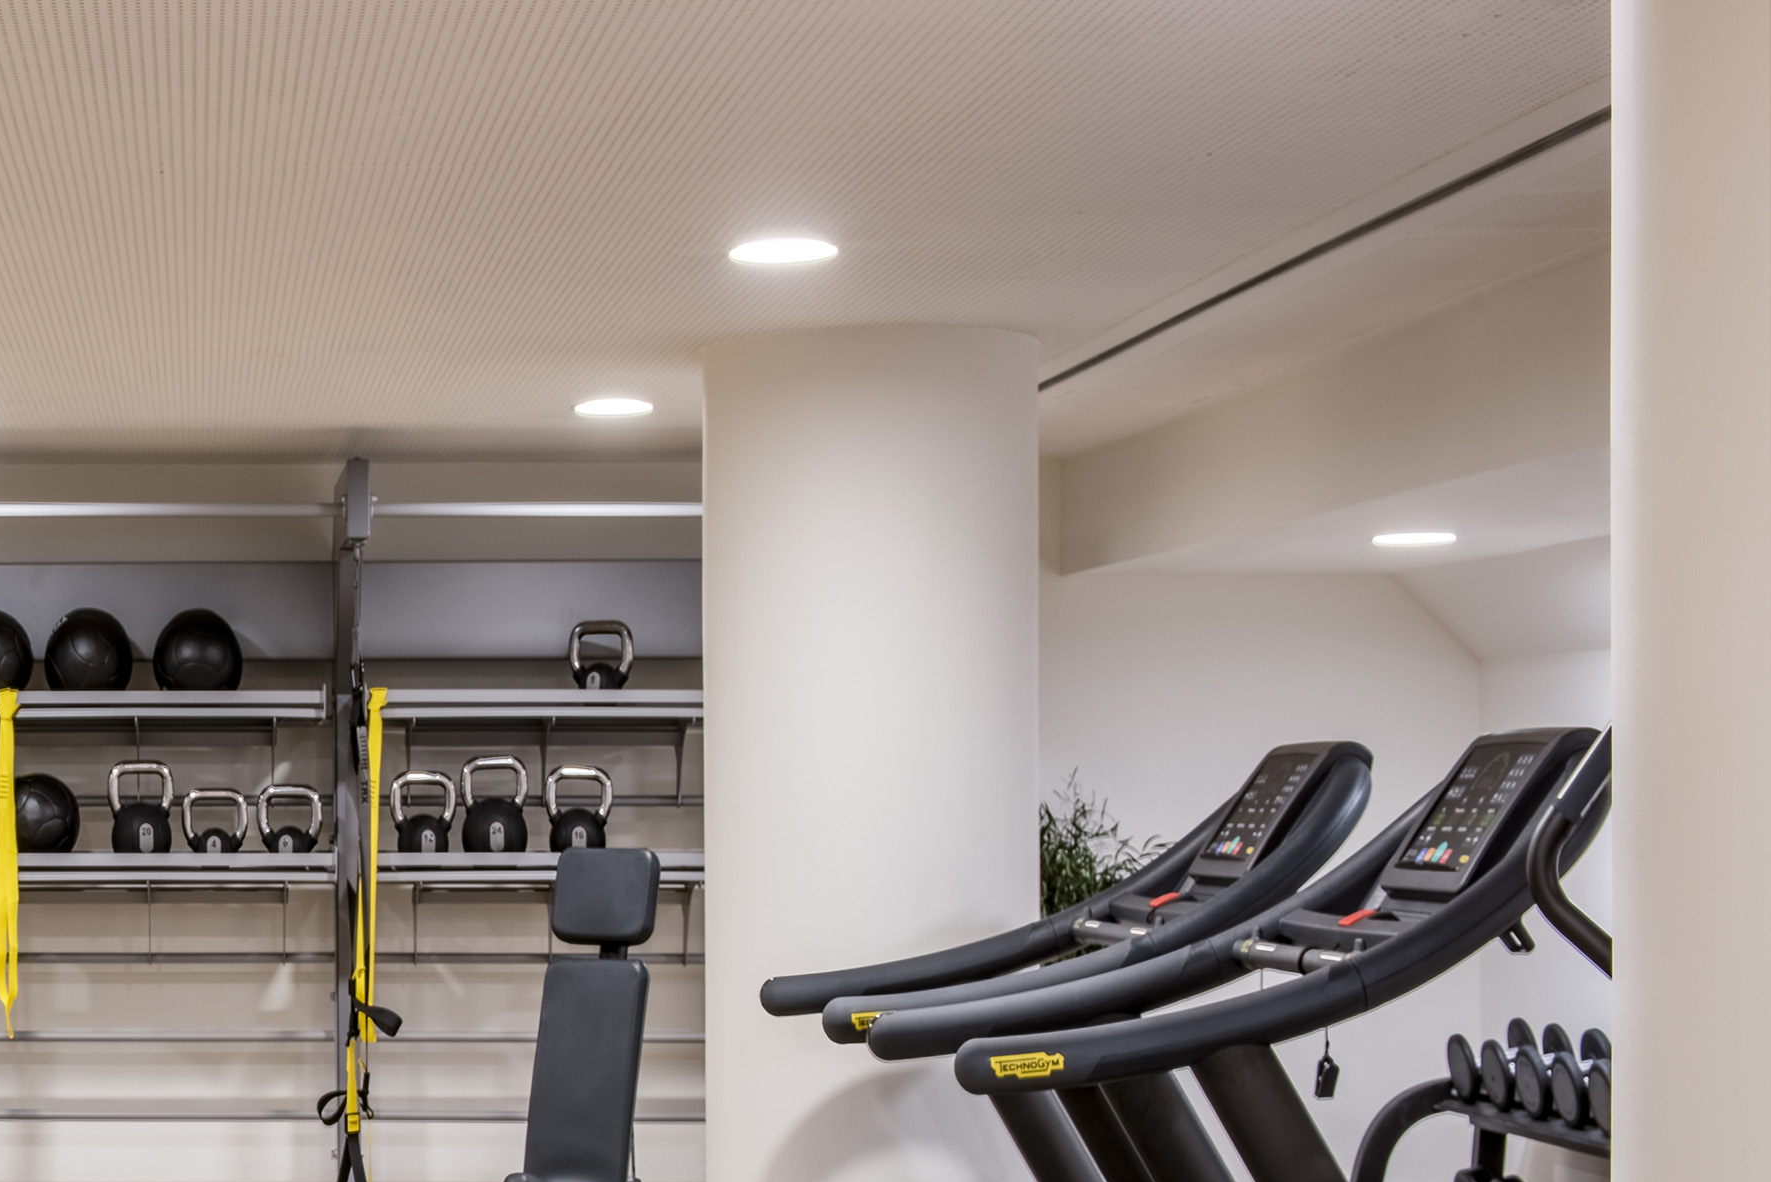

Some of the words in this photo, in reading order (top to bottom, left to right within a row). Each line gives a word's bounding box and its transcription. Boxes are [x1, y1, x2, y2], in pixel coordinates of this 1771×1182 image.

[141, 827, 152, 836] 20
[491, 826, 502, 835] 24
[574, 830, 585, 840] 16
[211, 840, 217, 848] 4
